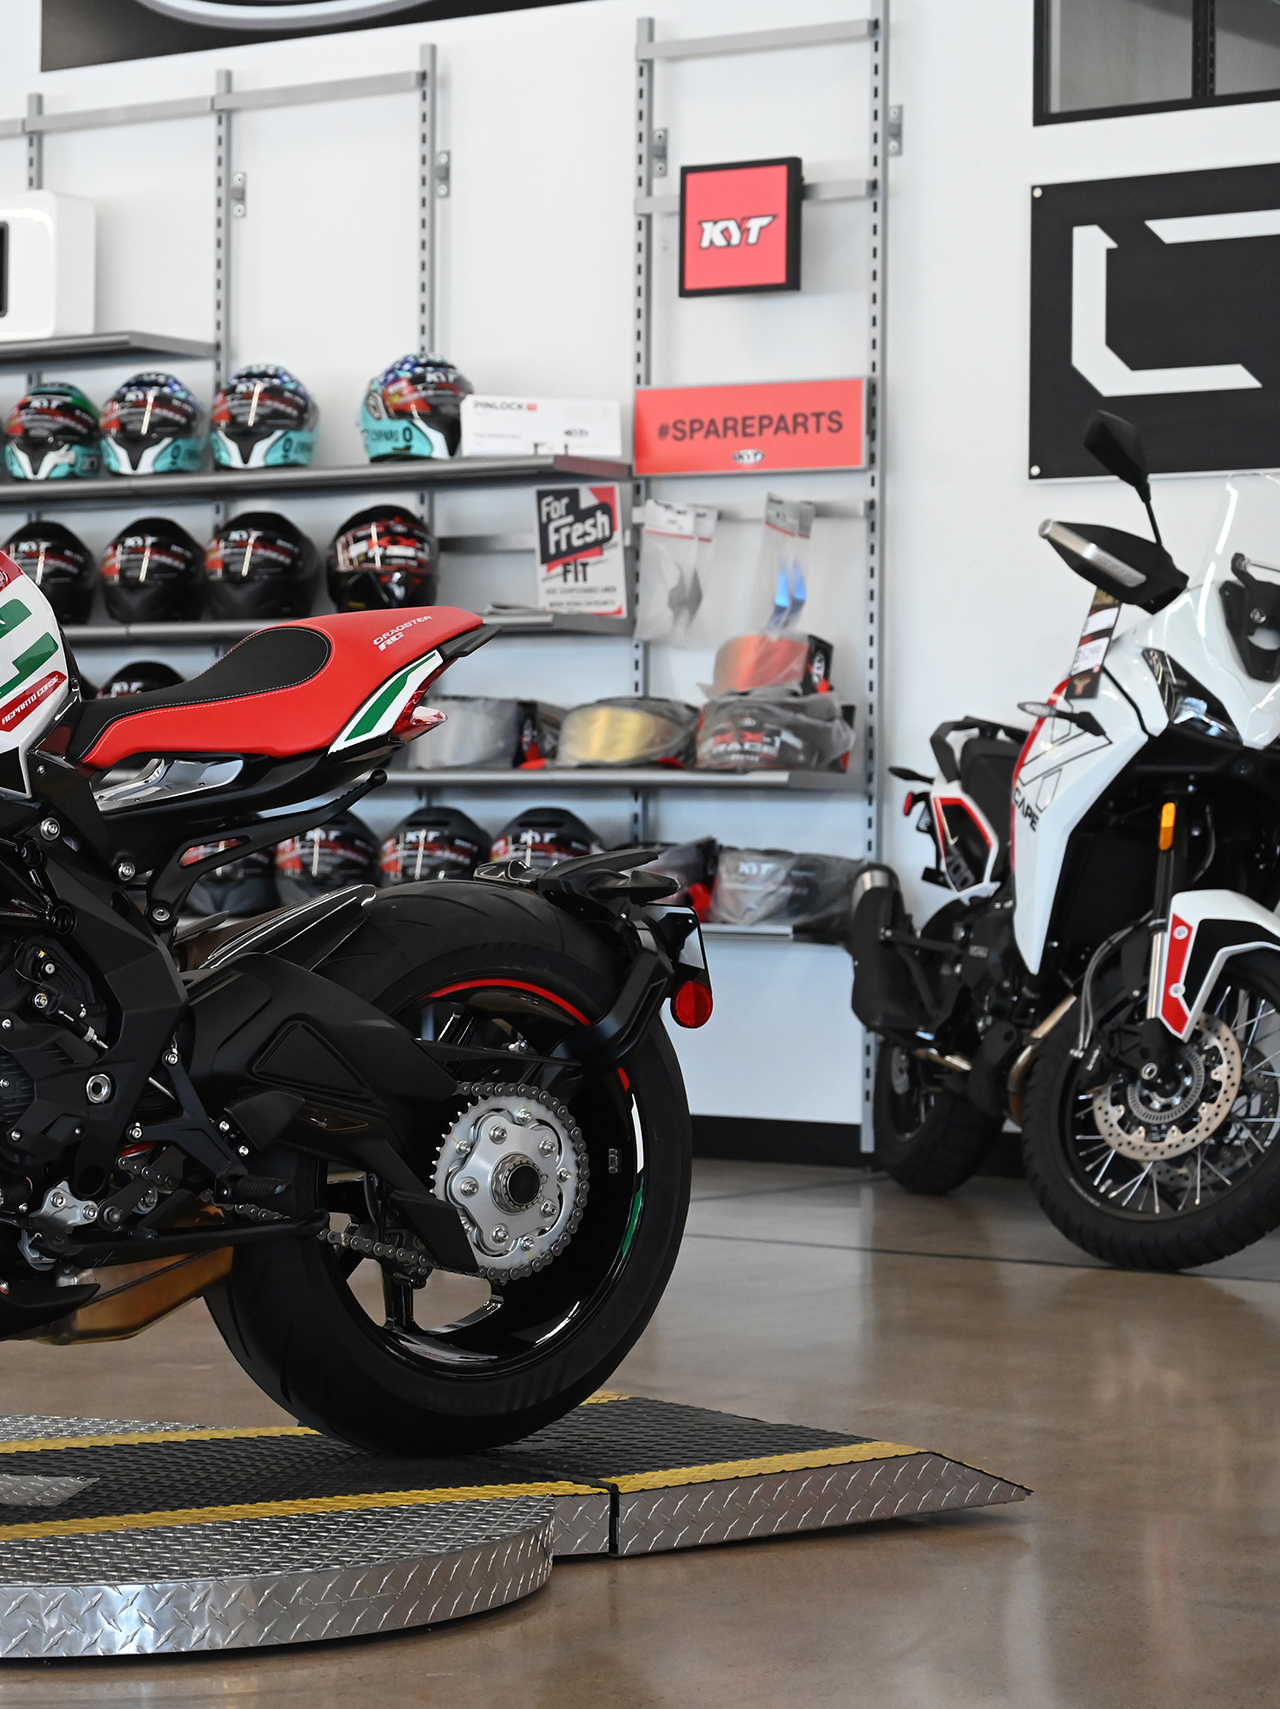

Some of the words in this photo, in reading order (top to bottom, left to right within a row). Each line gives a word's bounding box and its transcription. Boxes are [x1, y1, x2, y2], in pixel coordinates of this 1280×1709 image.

[699, 215, 777, 249] KYT
[658, 410, 844, 442] #SPAREPARTS
[541, 495, 571, 523] For
[548, 510, 610, 555] Fresh
[563, 557, 590, 583] FIT
[373, 615, 433, 646] DRAGSTER
[378, 632, 405, 652] RC
[1, 693, 38, 725] REPARTO
[36, 675, 59, 697] CORSE
